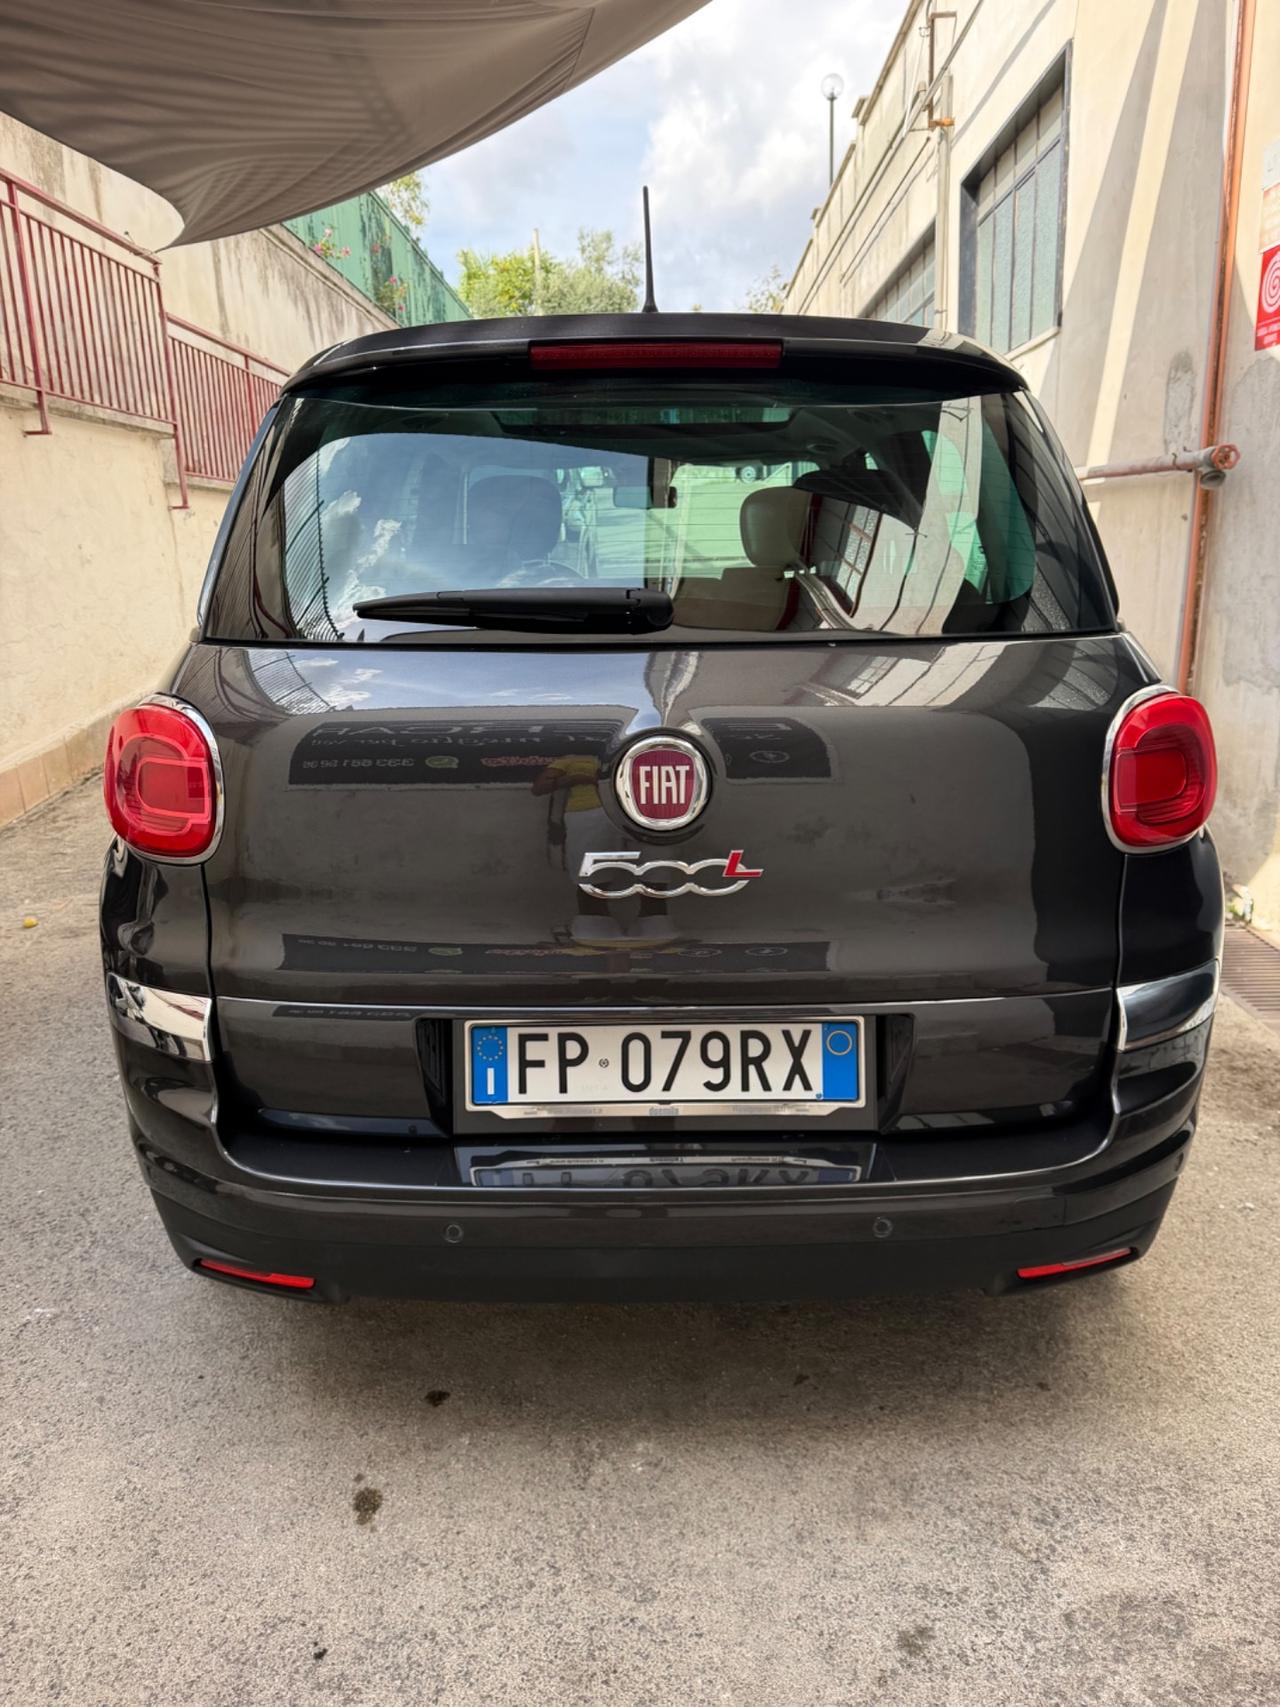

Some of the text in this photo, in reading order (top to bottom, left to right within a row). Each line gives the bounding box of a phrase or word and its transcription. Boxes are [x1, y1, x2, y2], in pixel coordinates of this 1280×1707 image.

[639, 765, 690, 805] FIAT
[578, 849, 765, 899] 500L
[518, 1029, 814, 1095] FP 079RX
